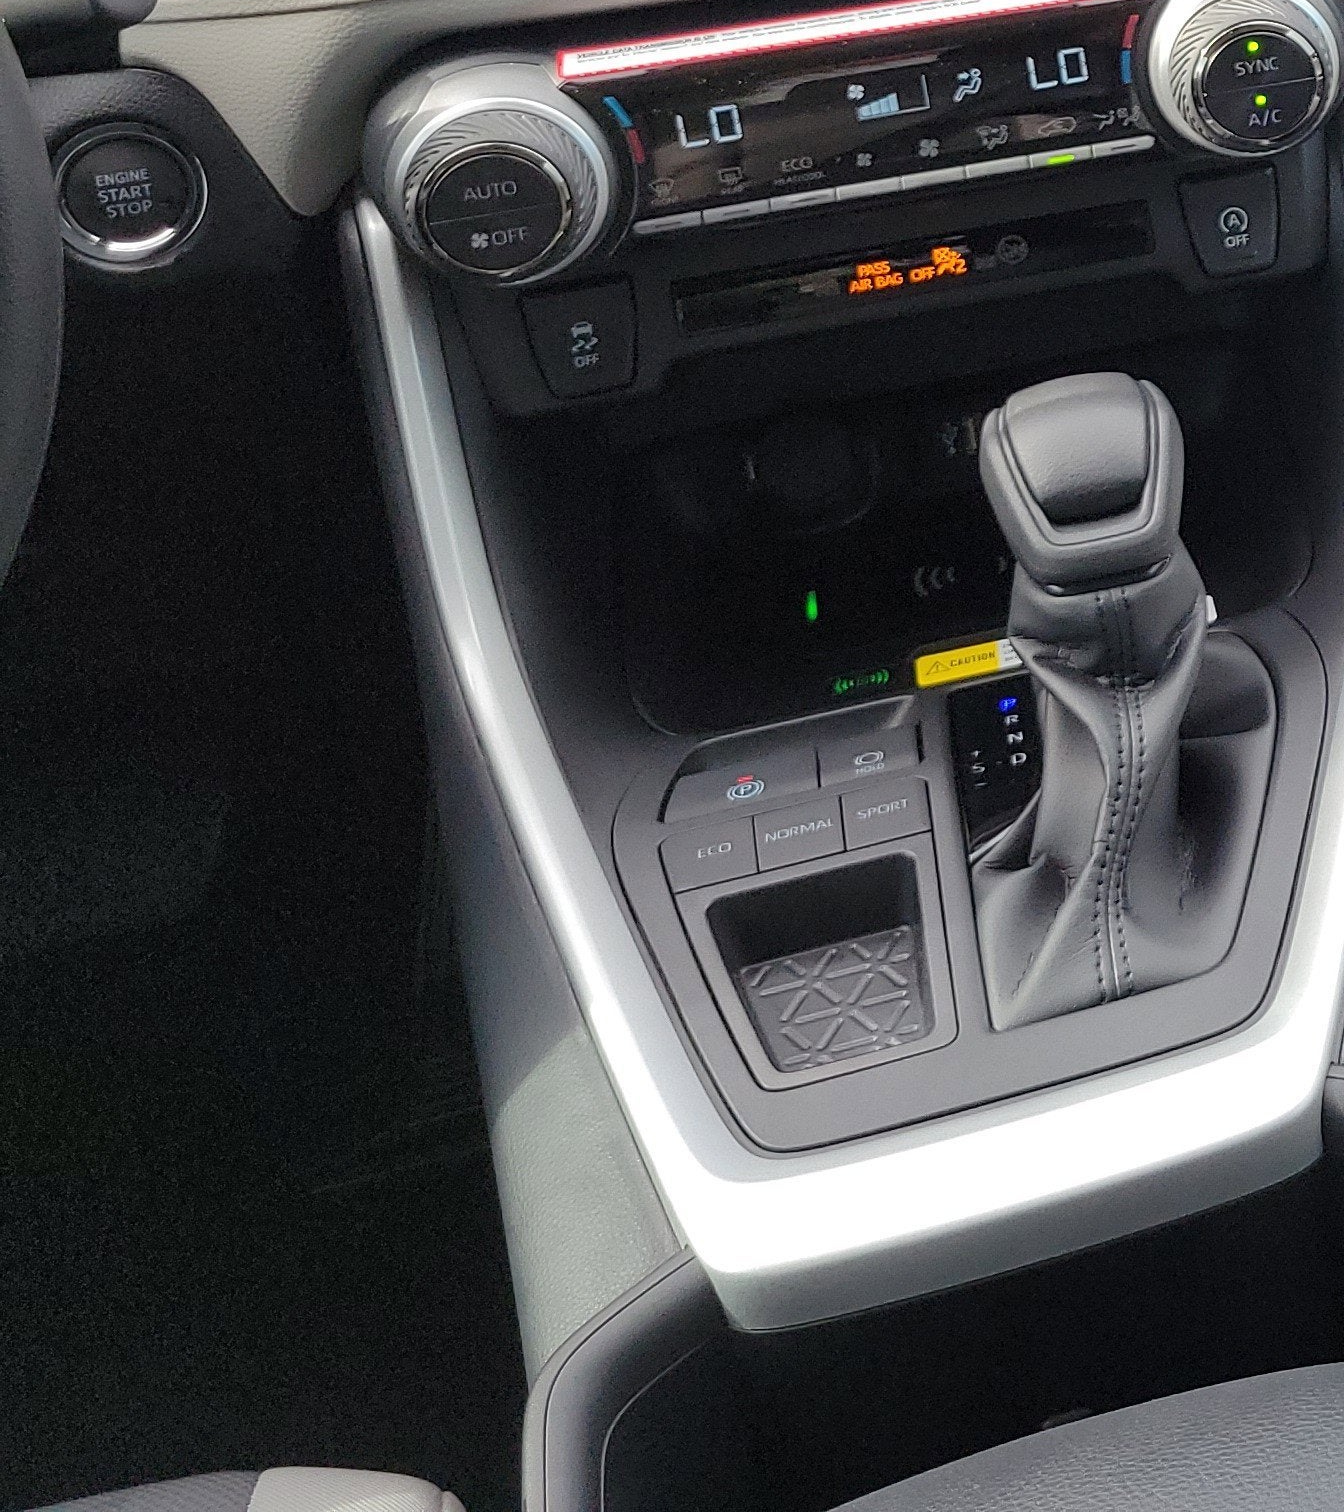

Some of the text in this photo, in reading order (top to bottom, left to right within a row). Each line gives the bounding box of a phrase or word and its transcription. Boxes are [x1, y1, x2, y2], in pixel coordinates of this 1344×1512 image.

[1026, 46, 1090, 90] LO
[1234, 56, 1279, 78] SYNC
[675, 103, 744, 149] LO
[1249, 108, 1282, 128] A/C
[782, 156, 813, 172] ECO
[95, 168, 151, 187] ENGINE
[97, 183, 152, 203] START
[464, 180, 518, 202] AUTO
[105, 199, 153, 218] STOP
[491, 225, 528, 246] OFF
[1224, 234, 1249, 248] OFF
[857, 260, 891, 278] PASS
[850, 266, 936, 294] AIR BAG OFF
[573, 352, 600, 368] OFF
[950, 650, 996, 668] CAUTION
[1007, 731, 1023, 745] N
[972, 762, 986, 774] S
[1010, 752, 1027, 766] D
[857, 798, 909, 820] SPORT
[765, 817, 834, 843] NORMAL
[697, 841, 732, 859] ECO
